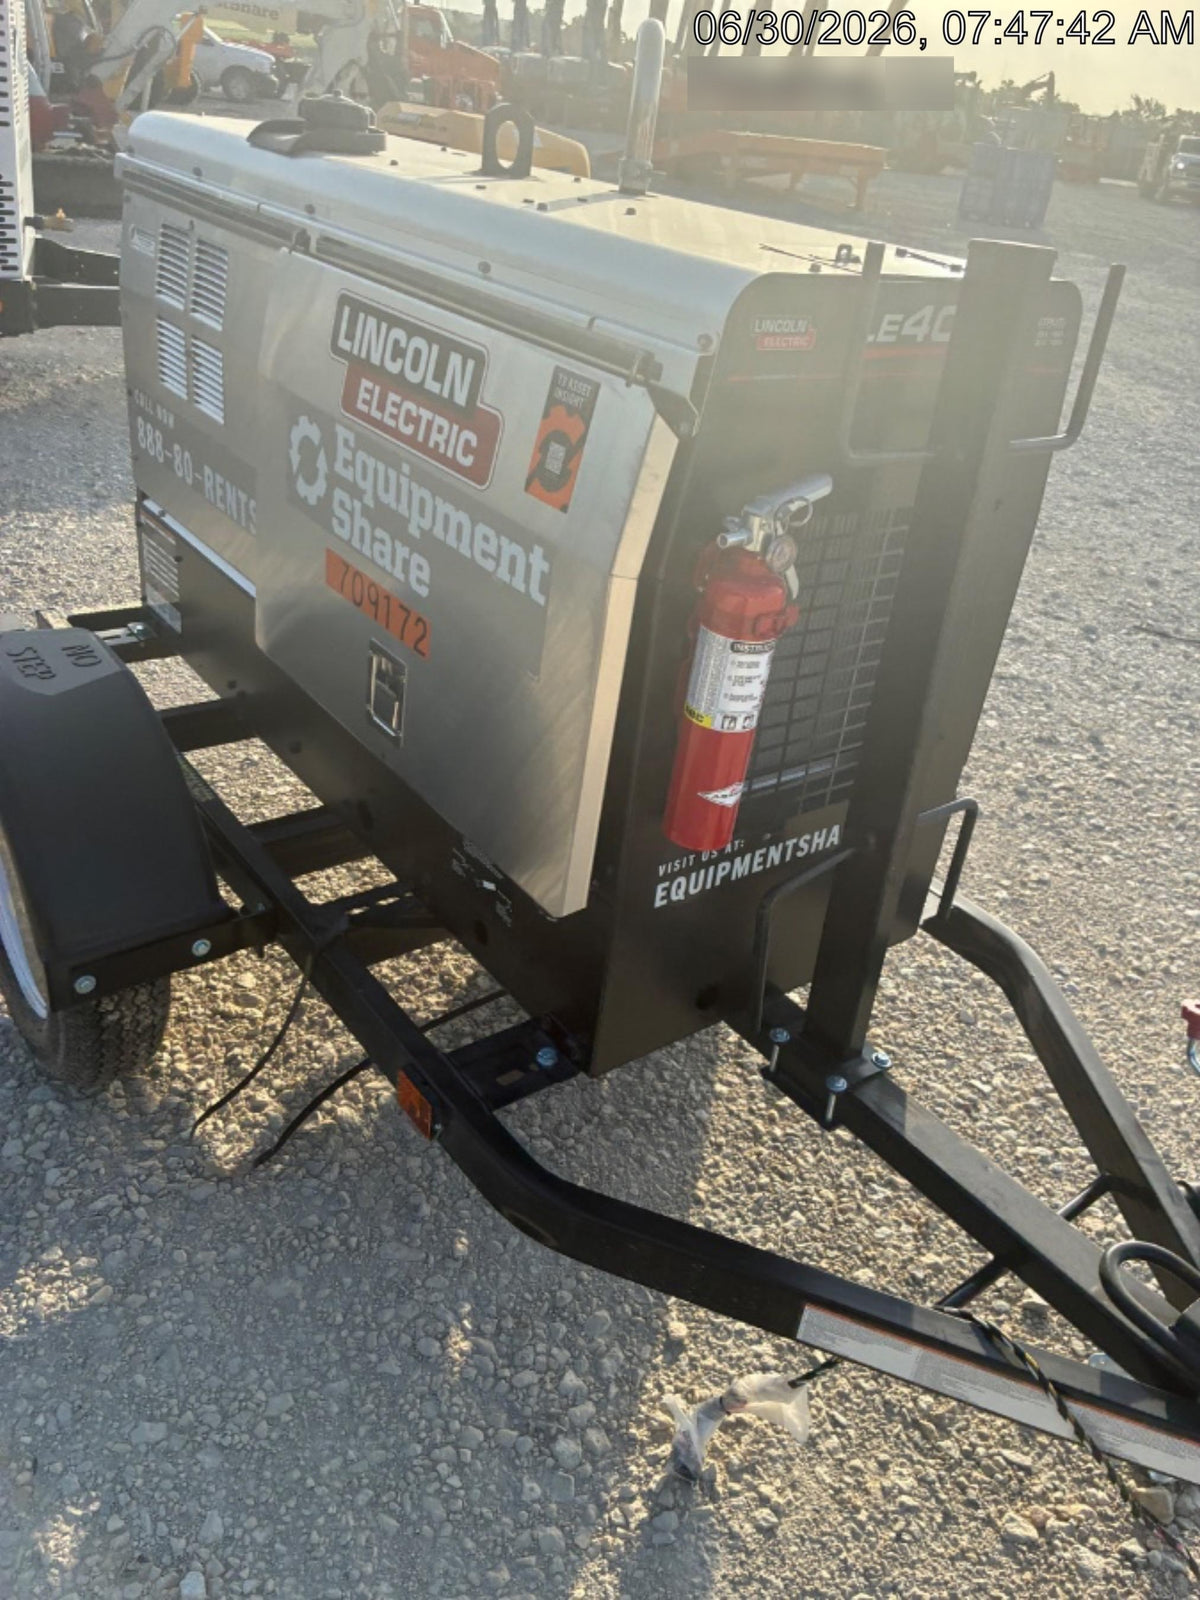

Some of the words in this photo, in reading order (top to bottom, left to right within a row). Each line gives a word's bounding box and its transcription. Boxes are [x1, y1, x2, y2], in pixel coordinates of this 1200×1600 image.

[338, 305, 475, 408] LINCOLN
[754, 318, 809, 333] LINCOLN
[356, 378, 478, 467] ELECTRIC
[137, 416, 257, 535] 888-80-RENTS
[334, 422, 550, 607] Equipment
[331, 486, 431, 599] Share
[340, 559, 429, 658] 709172
[6, 646, 57, 680] STEP
[61, 644, 102, 668] NO
[654, 824, 841, 909] EQUIPMENTSHA
[658, 853, 696, 877] VISIT
